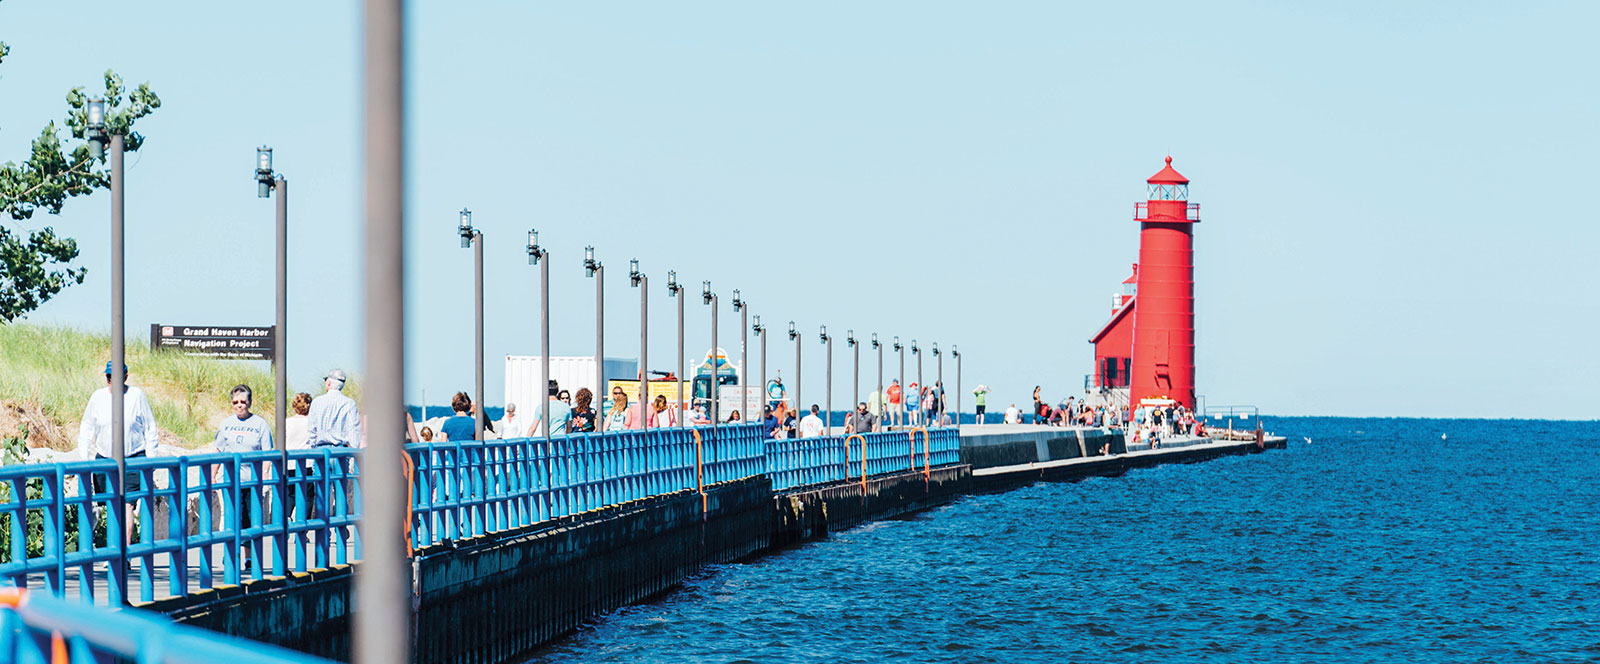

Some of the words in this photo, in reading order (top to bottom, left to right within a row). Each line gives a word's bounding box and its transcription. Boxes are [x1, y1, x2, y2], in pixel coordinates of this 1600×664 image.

[183, 328, 209, 336] Grand
[211, 328, 238, 336] Haven
[240, 328, 269, 336] Harbor
[183, 340, 227, 349] Navigation
[229, 340, 260, 349] Project
